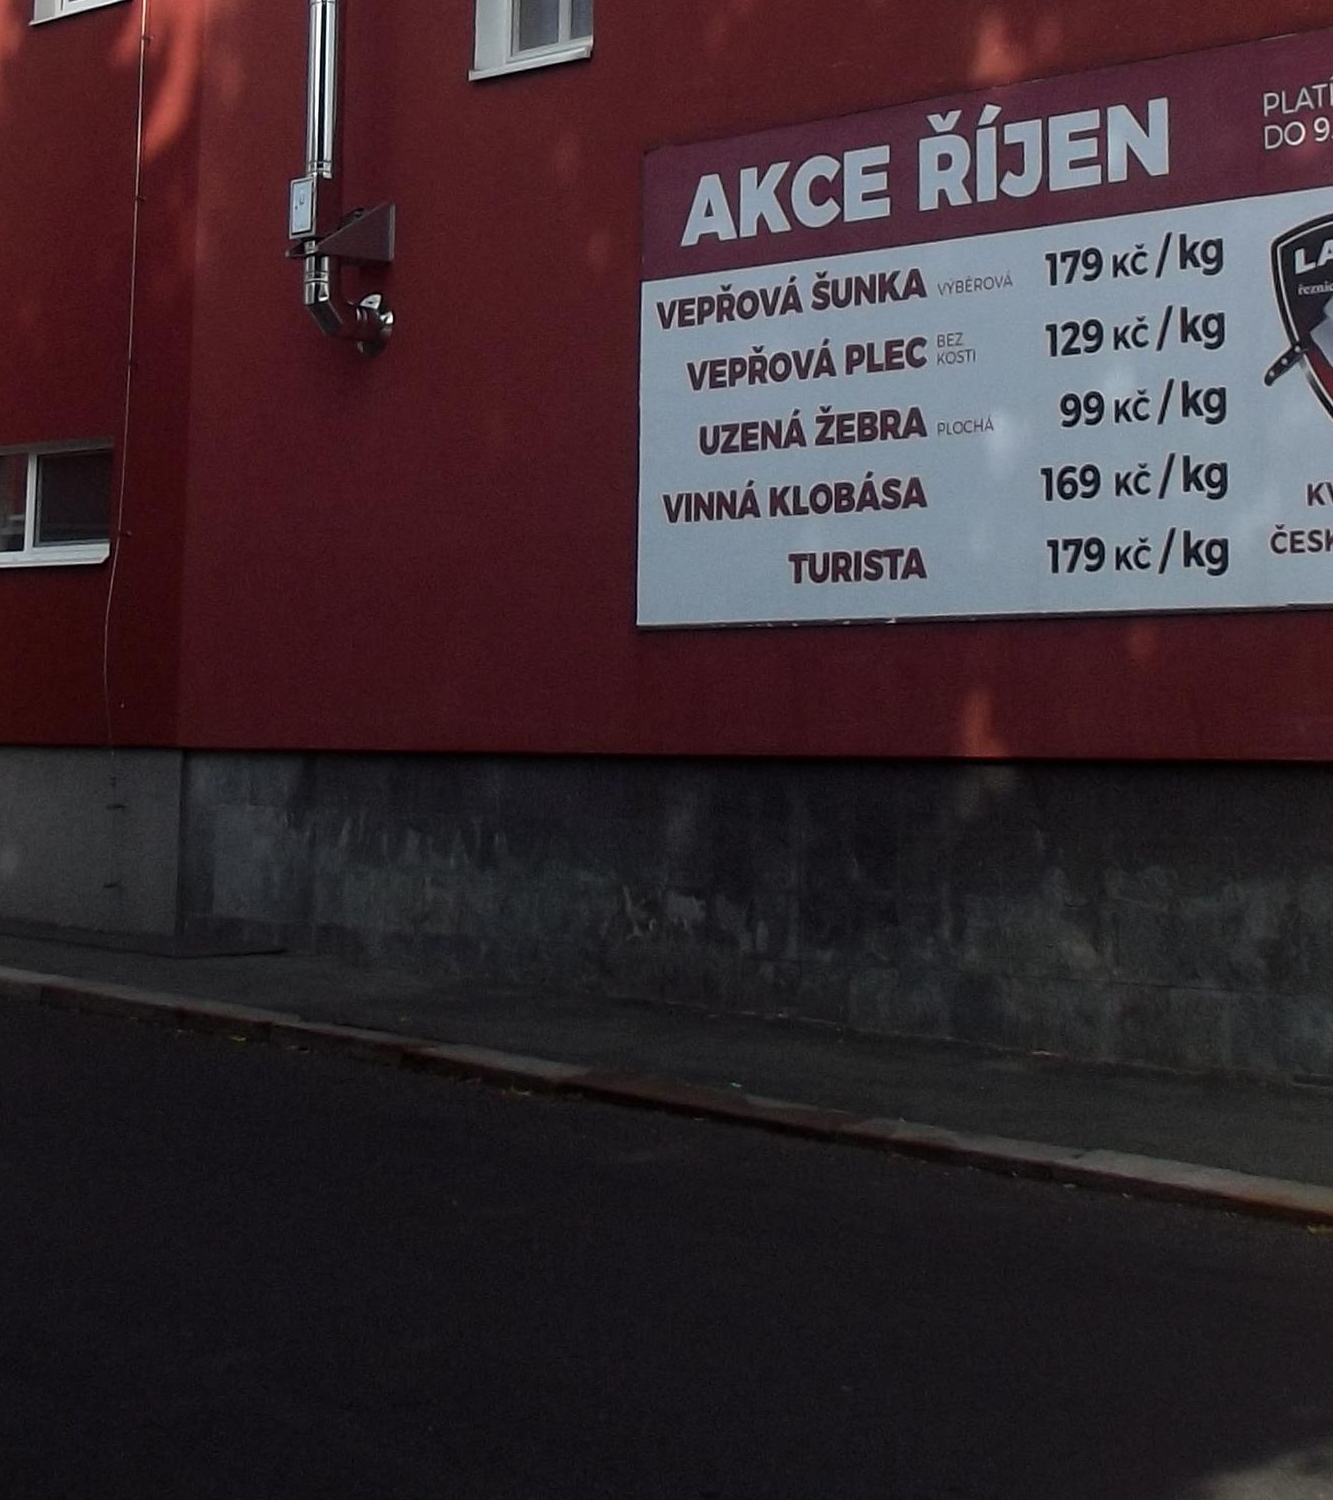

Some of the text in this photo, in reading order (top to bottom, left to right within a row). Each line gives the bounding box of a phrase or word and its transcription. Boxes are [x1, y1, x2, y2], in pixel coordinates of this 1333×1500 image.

[1264, 121, 1306, 150] DO
[680, 97, 1169, 247] AKCE ŘÍJEN
[1045, 247, 1103, 286] 179
[657, 276, 803, 329] VEPŘOVÁ
[811, 268, 927, 311] ŠUNKA
[936, 332, 964, 348] BEZ
[1045, 319, 1104, 357] 129
[687, 337, 927, 391] VEPŘOVÁ PLEC
[936, 349, 976, 366] KOSTI
[1060, 391, 1105, 427] 99
[699, 406, 994, 455] UZENÁ ŽEBRA PLOCHÁ
[663, 471, 927, 523] VINNÁ KLOBÁSA
[1040, 464, 1101, 501] 169
[788, 548, 927, 584] TURISTA
[1047, 537, 1105, 573] 179
